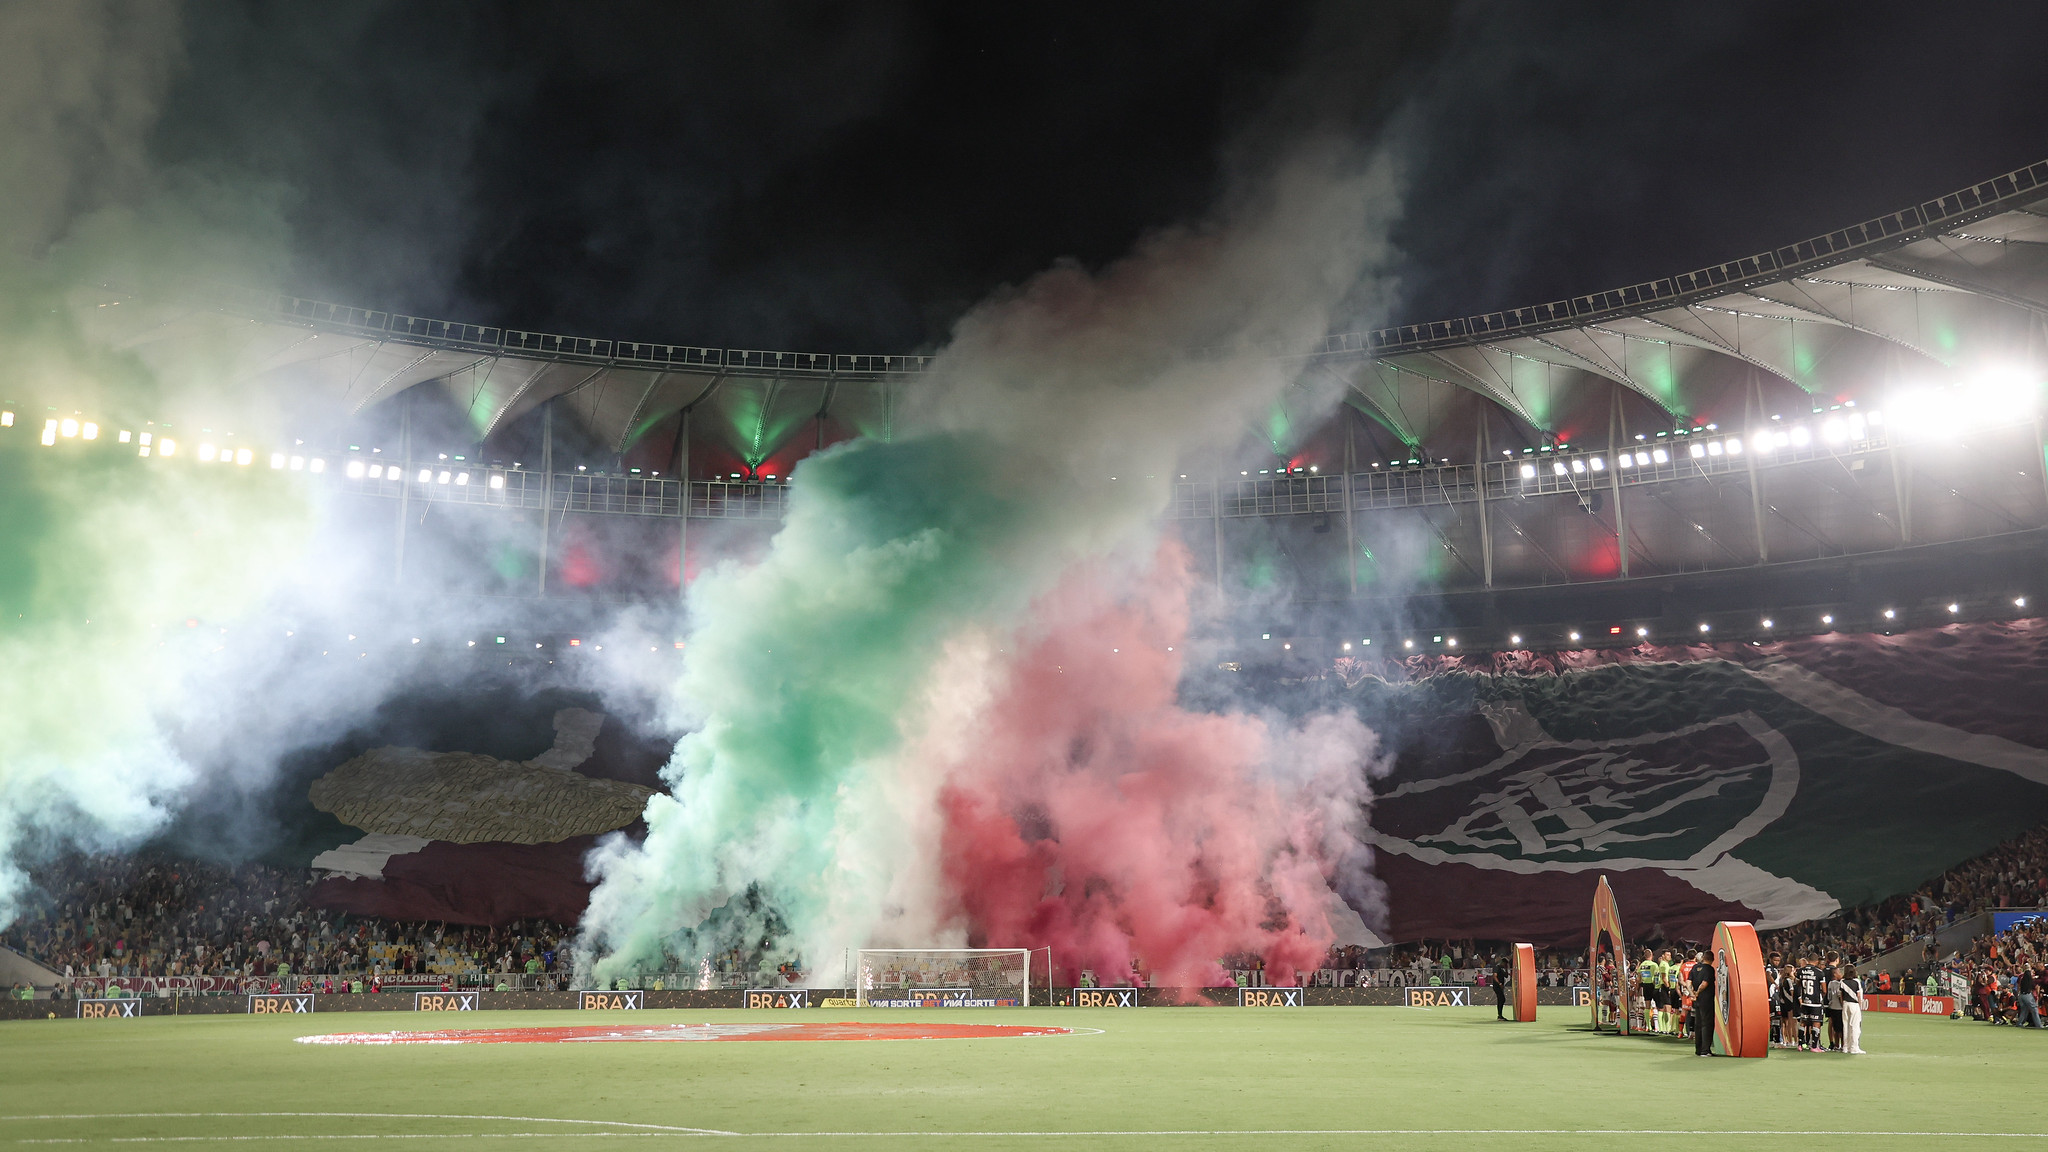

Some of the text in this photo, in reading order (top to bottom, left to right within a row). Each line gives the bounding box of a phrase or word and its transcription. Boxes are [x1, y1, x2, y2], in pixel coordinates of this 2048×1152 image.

[254, 998, 308, 1014] BRAX
[421, 996, 473, 1012] BRAX
[585, 994, 638, 1010] BRAX
[1079, 992, 1132, 1007] BRAX
[1245, 992, 1298, 1006] BRAX
[1411, 991, 1464, 1006] BRAX
[1922, 996, 1944, 1014] Betano
[82, 1002, 136, 1018] BRAX
